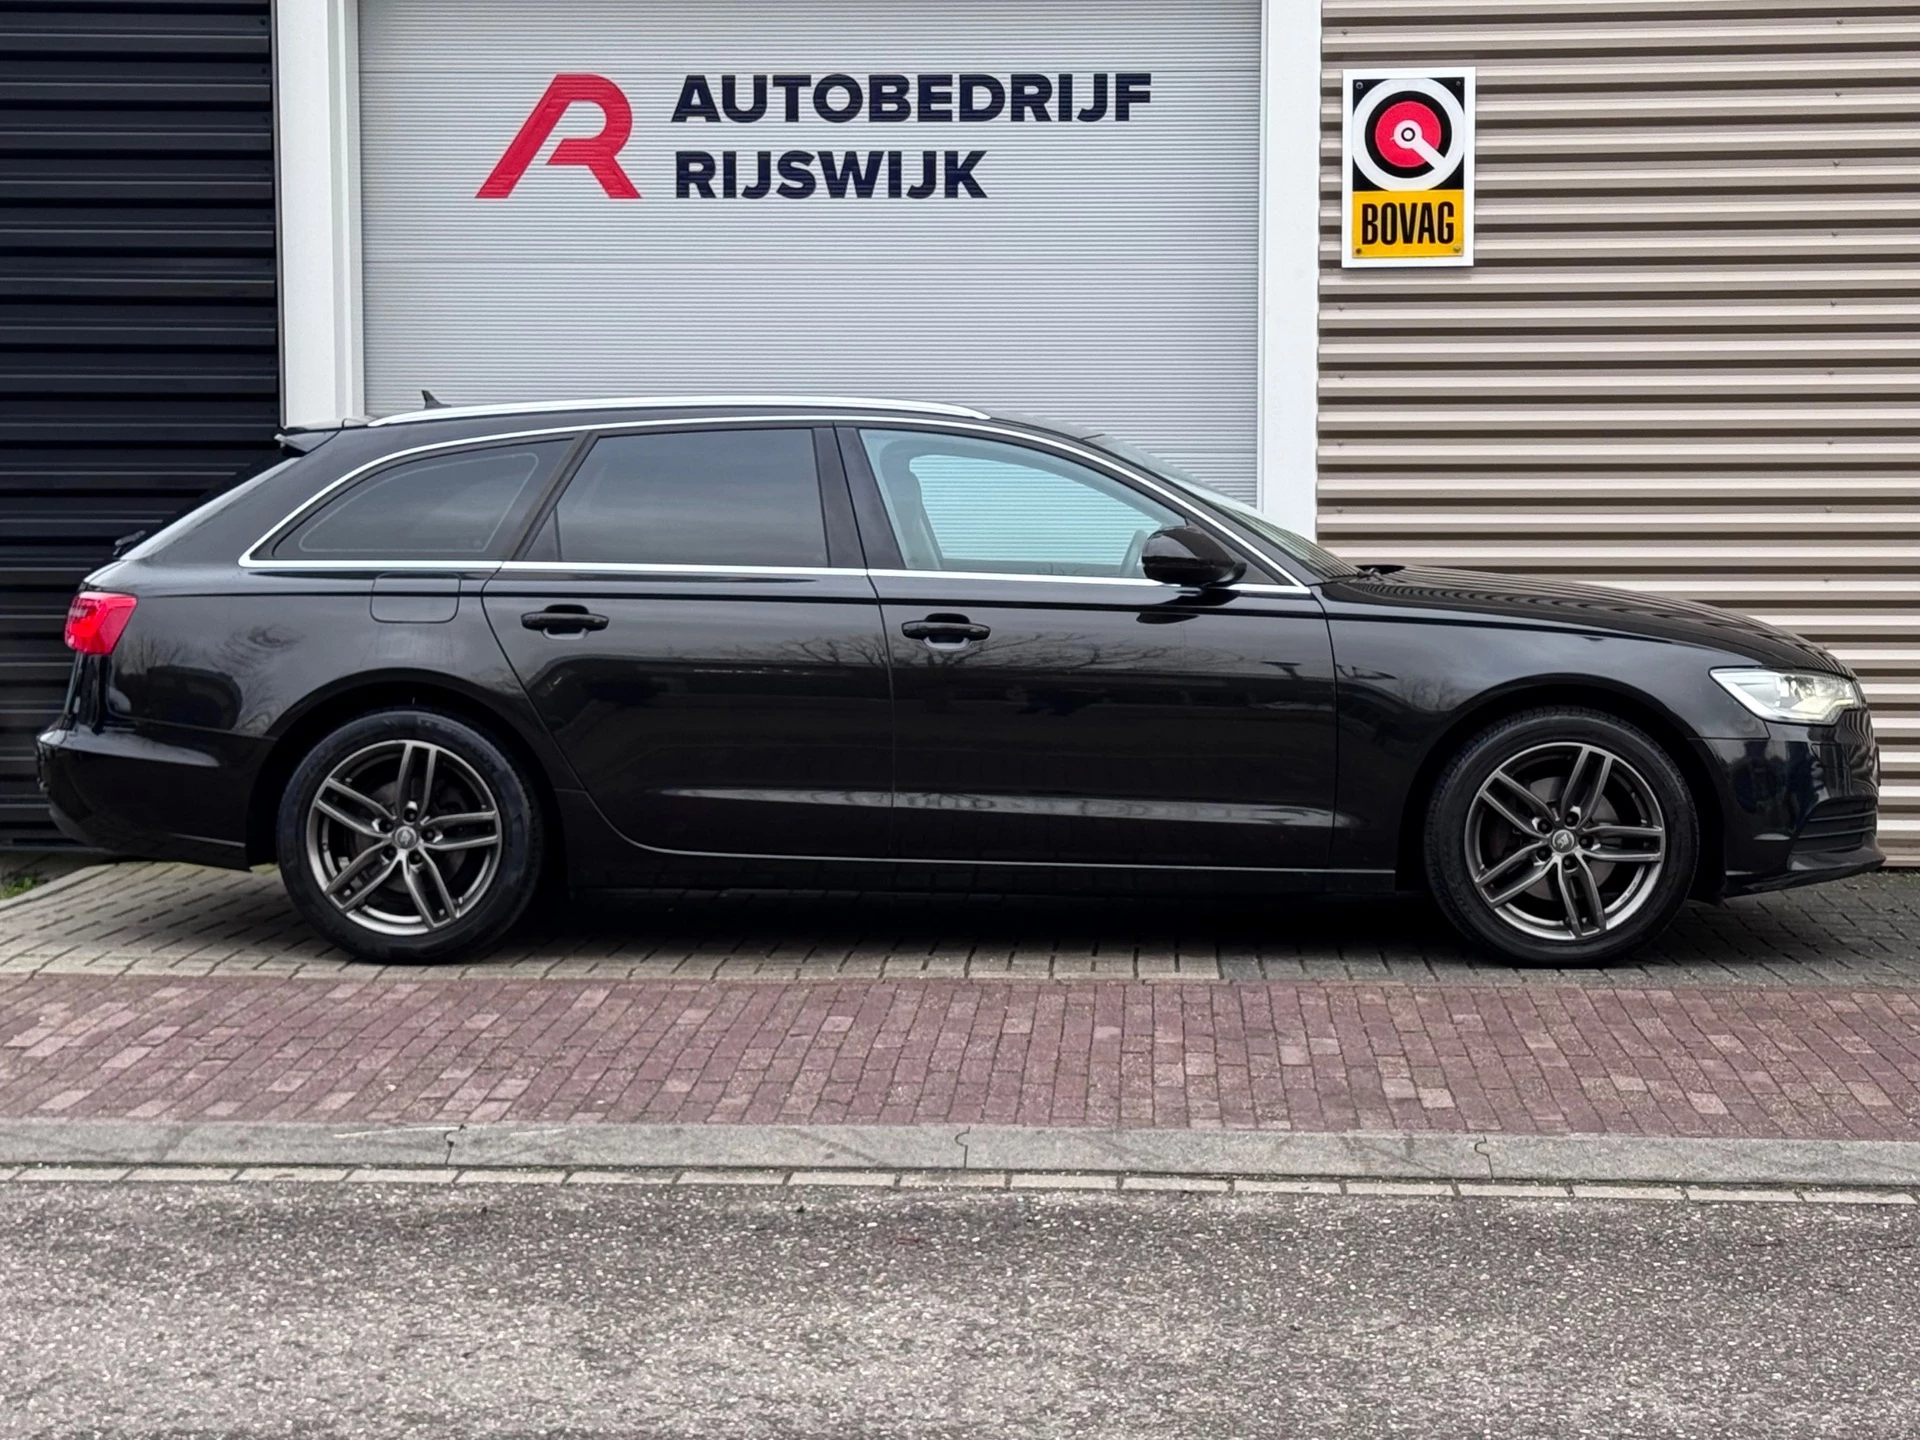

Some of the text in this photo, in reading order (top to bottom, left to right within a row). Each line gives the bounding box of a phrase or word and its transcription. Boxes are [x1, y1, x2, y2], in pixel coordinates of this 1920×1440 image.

[671, 73, 1152, 123] AUTOBEDRIJF
[676, 150, 988, 200] RIJSWIJK
[1362, 202, 1454, 245] BOVAG
